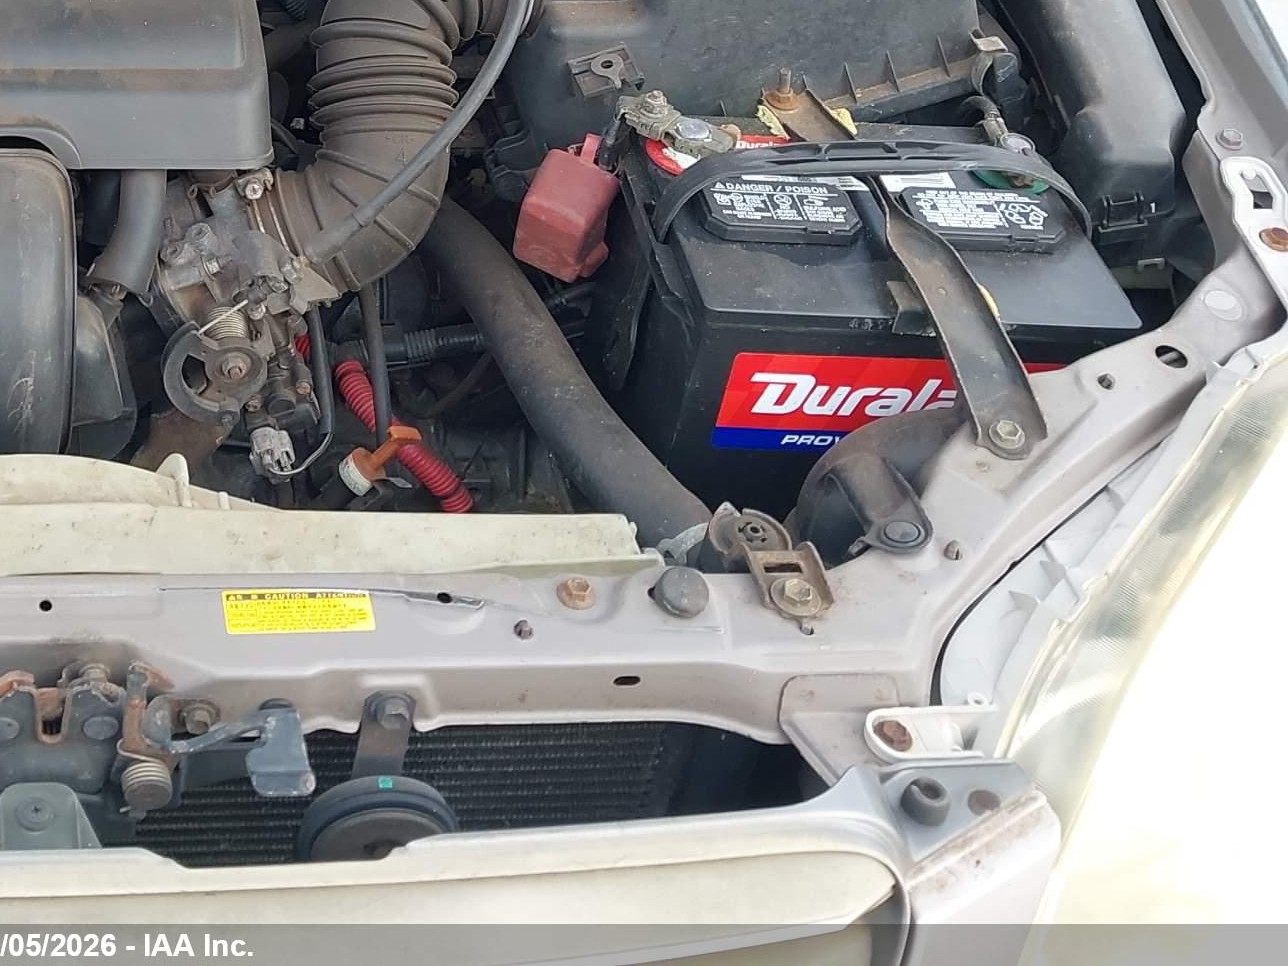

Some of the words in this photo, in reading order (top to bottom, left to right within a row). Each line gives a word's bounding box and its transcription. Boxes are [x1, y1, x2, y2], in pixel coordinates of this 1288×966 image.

[725, 182, 773, 192] DANGER
[784, 185, 829, 194] POISON
[264, 592, 309, 601] CAUTION
